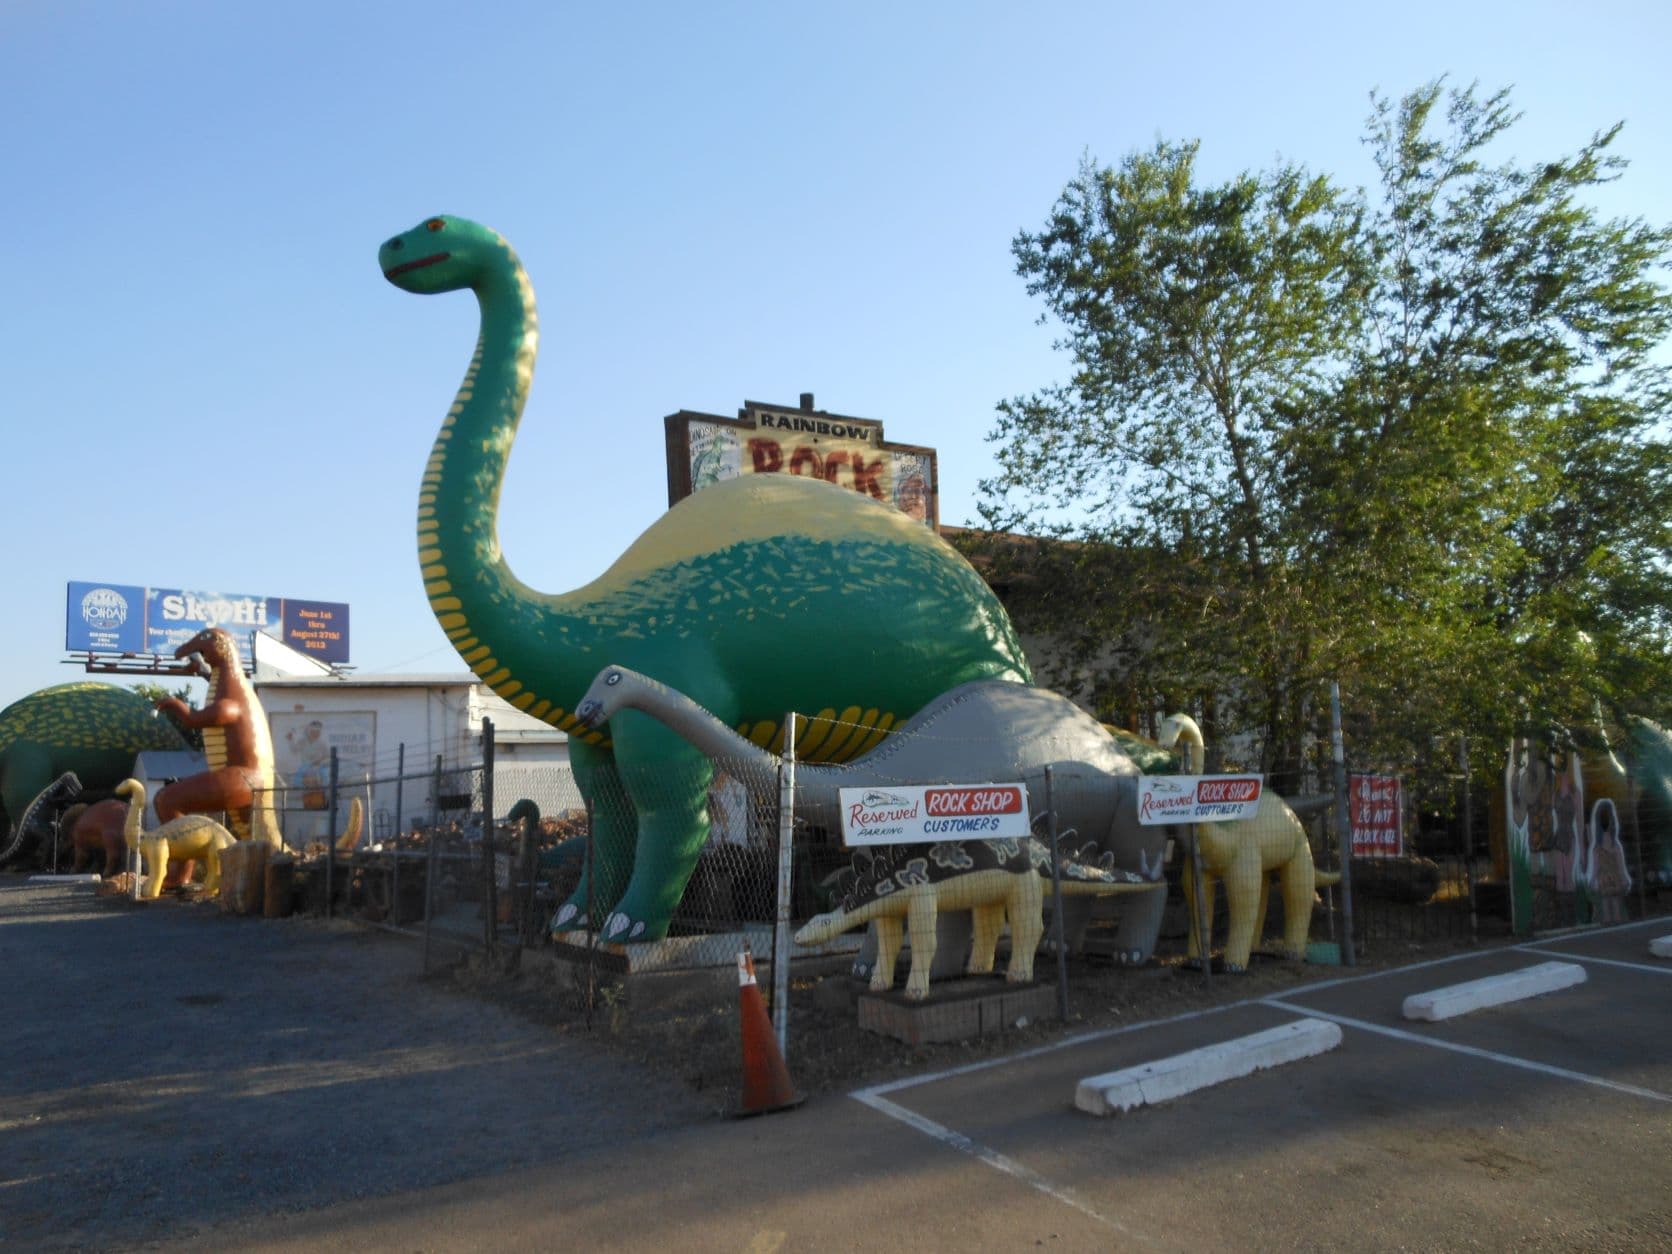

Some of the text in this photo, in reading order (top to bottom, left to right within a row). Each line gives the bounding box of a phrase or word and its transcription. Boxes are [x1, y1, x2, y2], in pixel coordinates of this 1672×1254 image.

[760, 413, 869, 440] RAINBOW
[747, 437, 885, 502] ROCK
[298, 609, 318, 618] June
[290, 629, 318, 639] August
[308, 620, 326, 629] thru
[849, 791, 1014, 828] Reserved ROCK SHOP
[1140, 782, 1255, 820] Reserved ROCK SHOP
[857, 826, 904, 837] PARKING
[923, 815, 1000, 834] CUSTOMER'S
